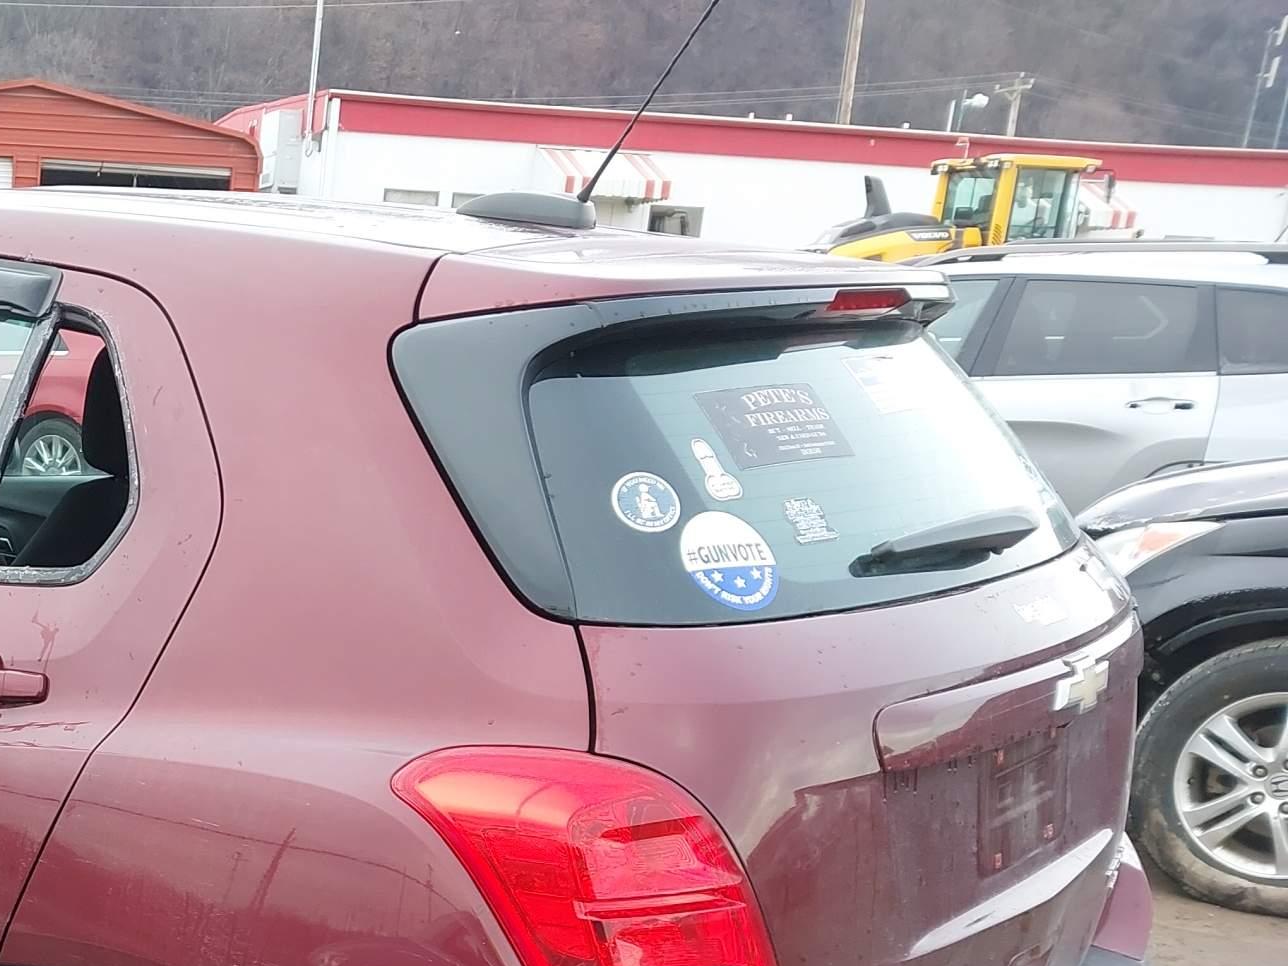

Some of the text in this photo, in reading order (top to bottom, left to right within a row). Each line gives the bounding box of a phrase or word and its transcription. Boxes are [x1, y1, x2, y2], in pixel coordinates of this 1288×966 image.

[740, 388, 813, 411] PETE'S
[744, 407, 830, 427] FIREARMS
[686, 543, 767, 564] #GUNVOTE
[695, 570, 721, 594] DON'T
